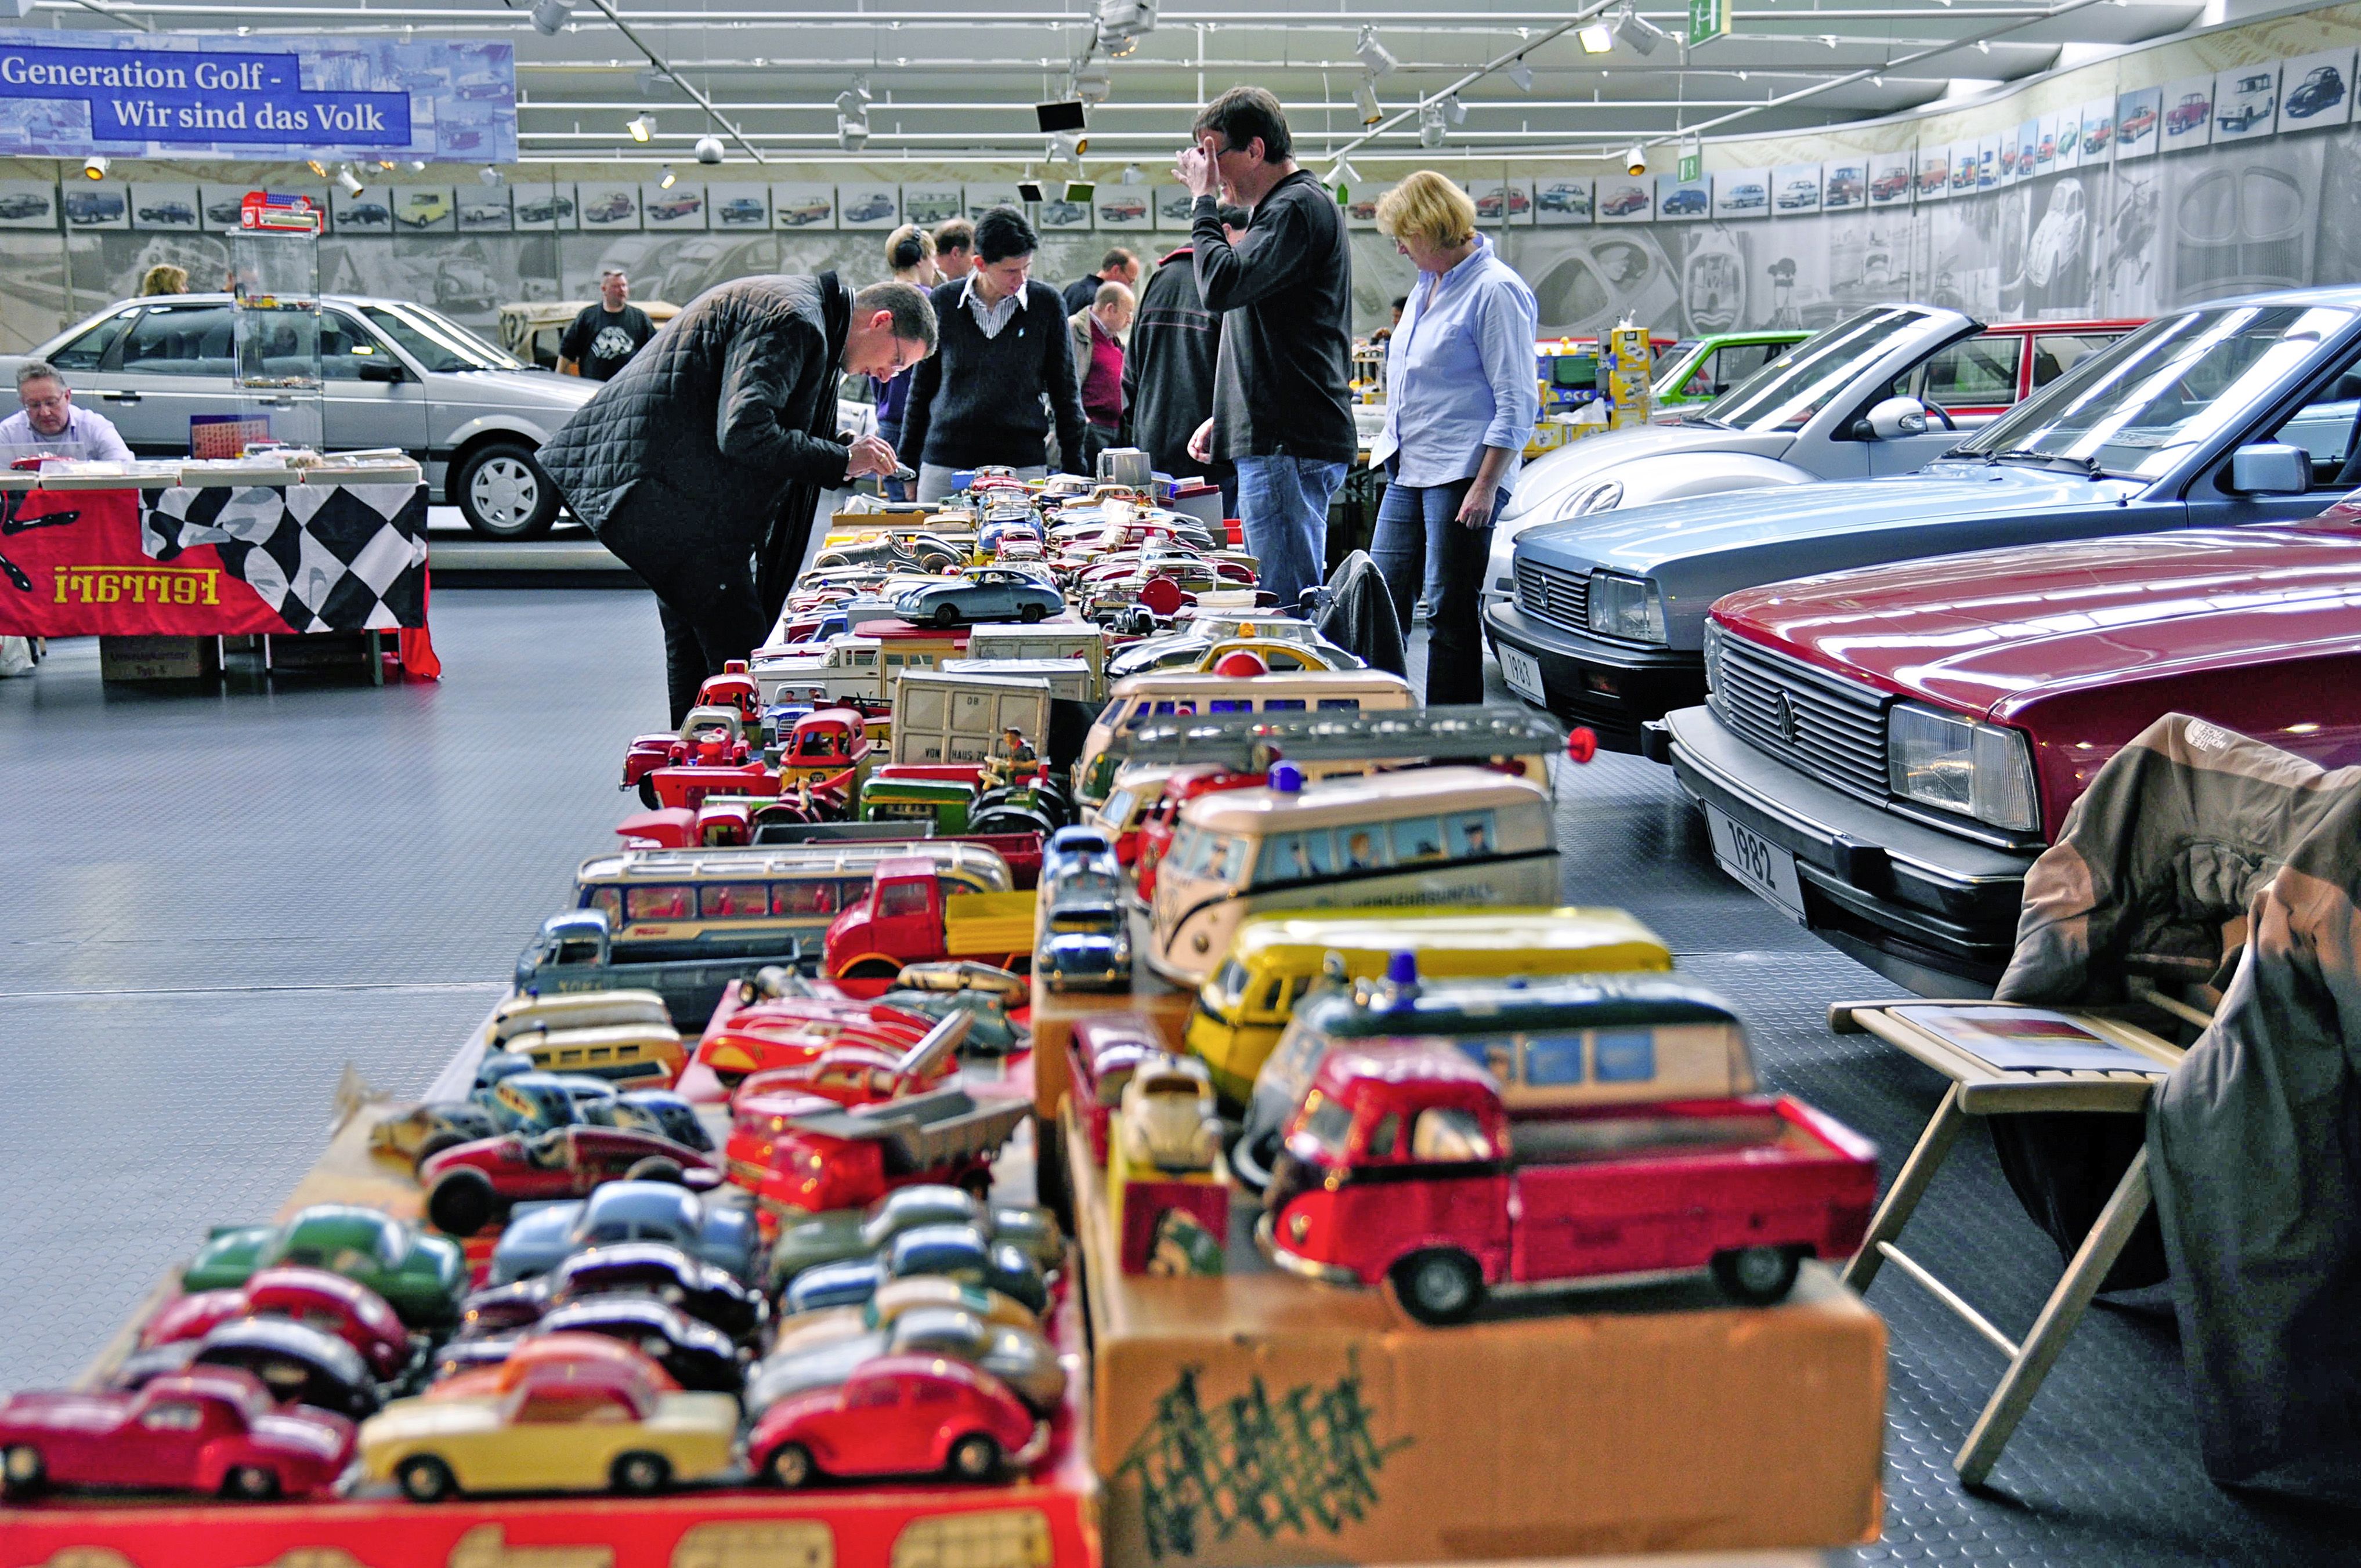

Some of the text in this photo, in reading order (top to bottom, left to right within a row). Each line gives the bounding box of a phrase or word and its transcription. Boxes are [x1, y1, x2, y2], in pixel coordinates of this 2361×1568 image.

[2, 56, 187, 89] Generation
[194, 62, 264, 90] Golf
[111, 100, 386, 132] Wir sind das Volk
[1507, 653, 1531, 687] 1983
[2192, 738, 2207, 752] THE
[2198, 731, 2227, 749] NORTH
[2204, 726, 2225, 740] FACE
[925, 748, 940, 759] VON
[952, 749, 972, 761] HAUS
[1727, 820, 1776, 891] 1982
